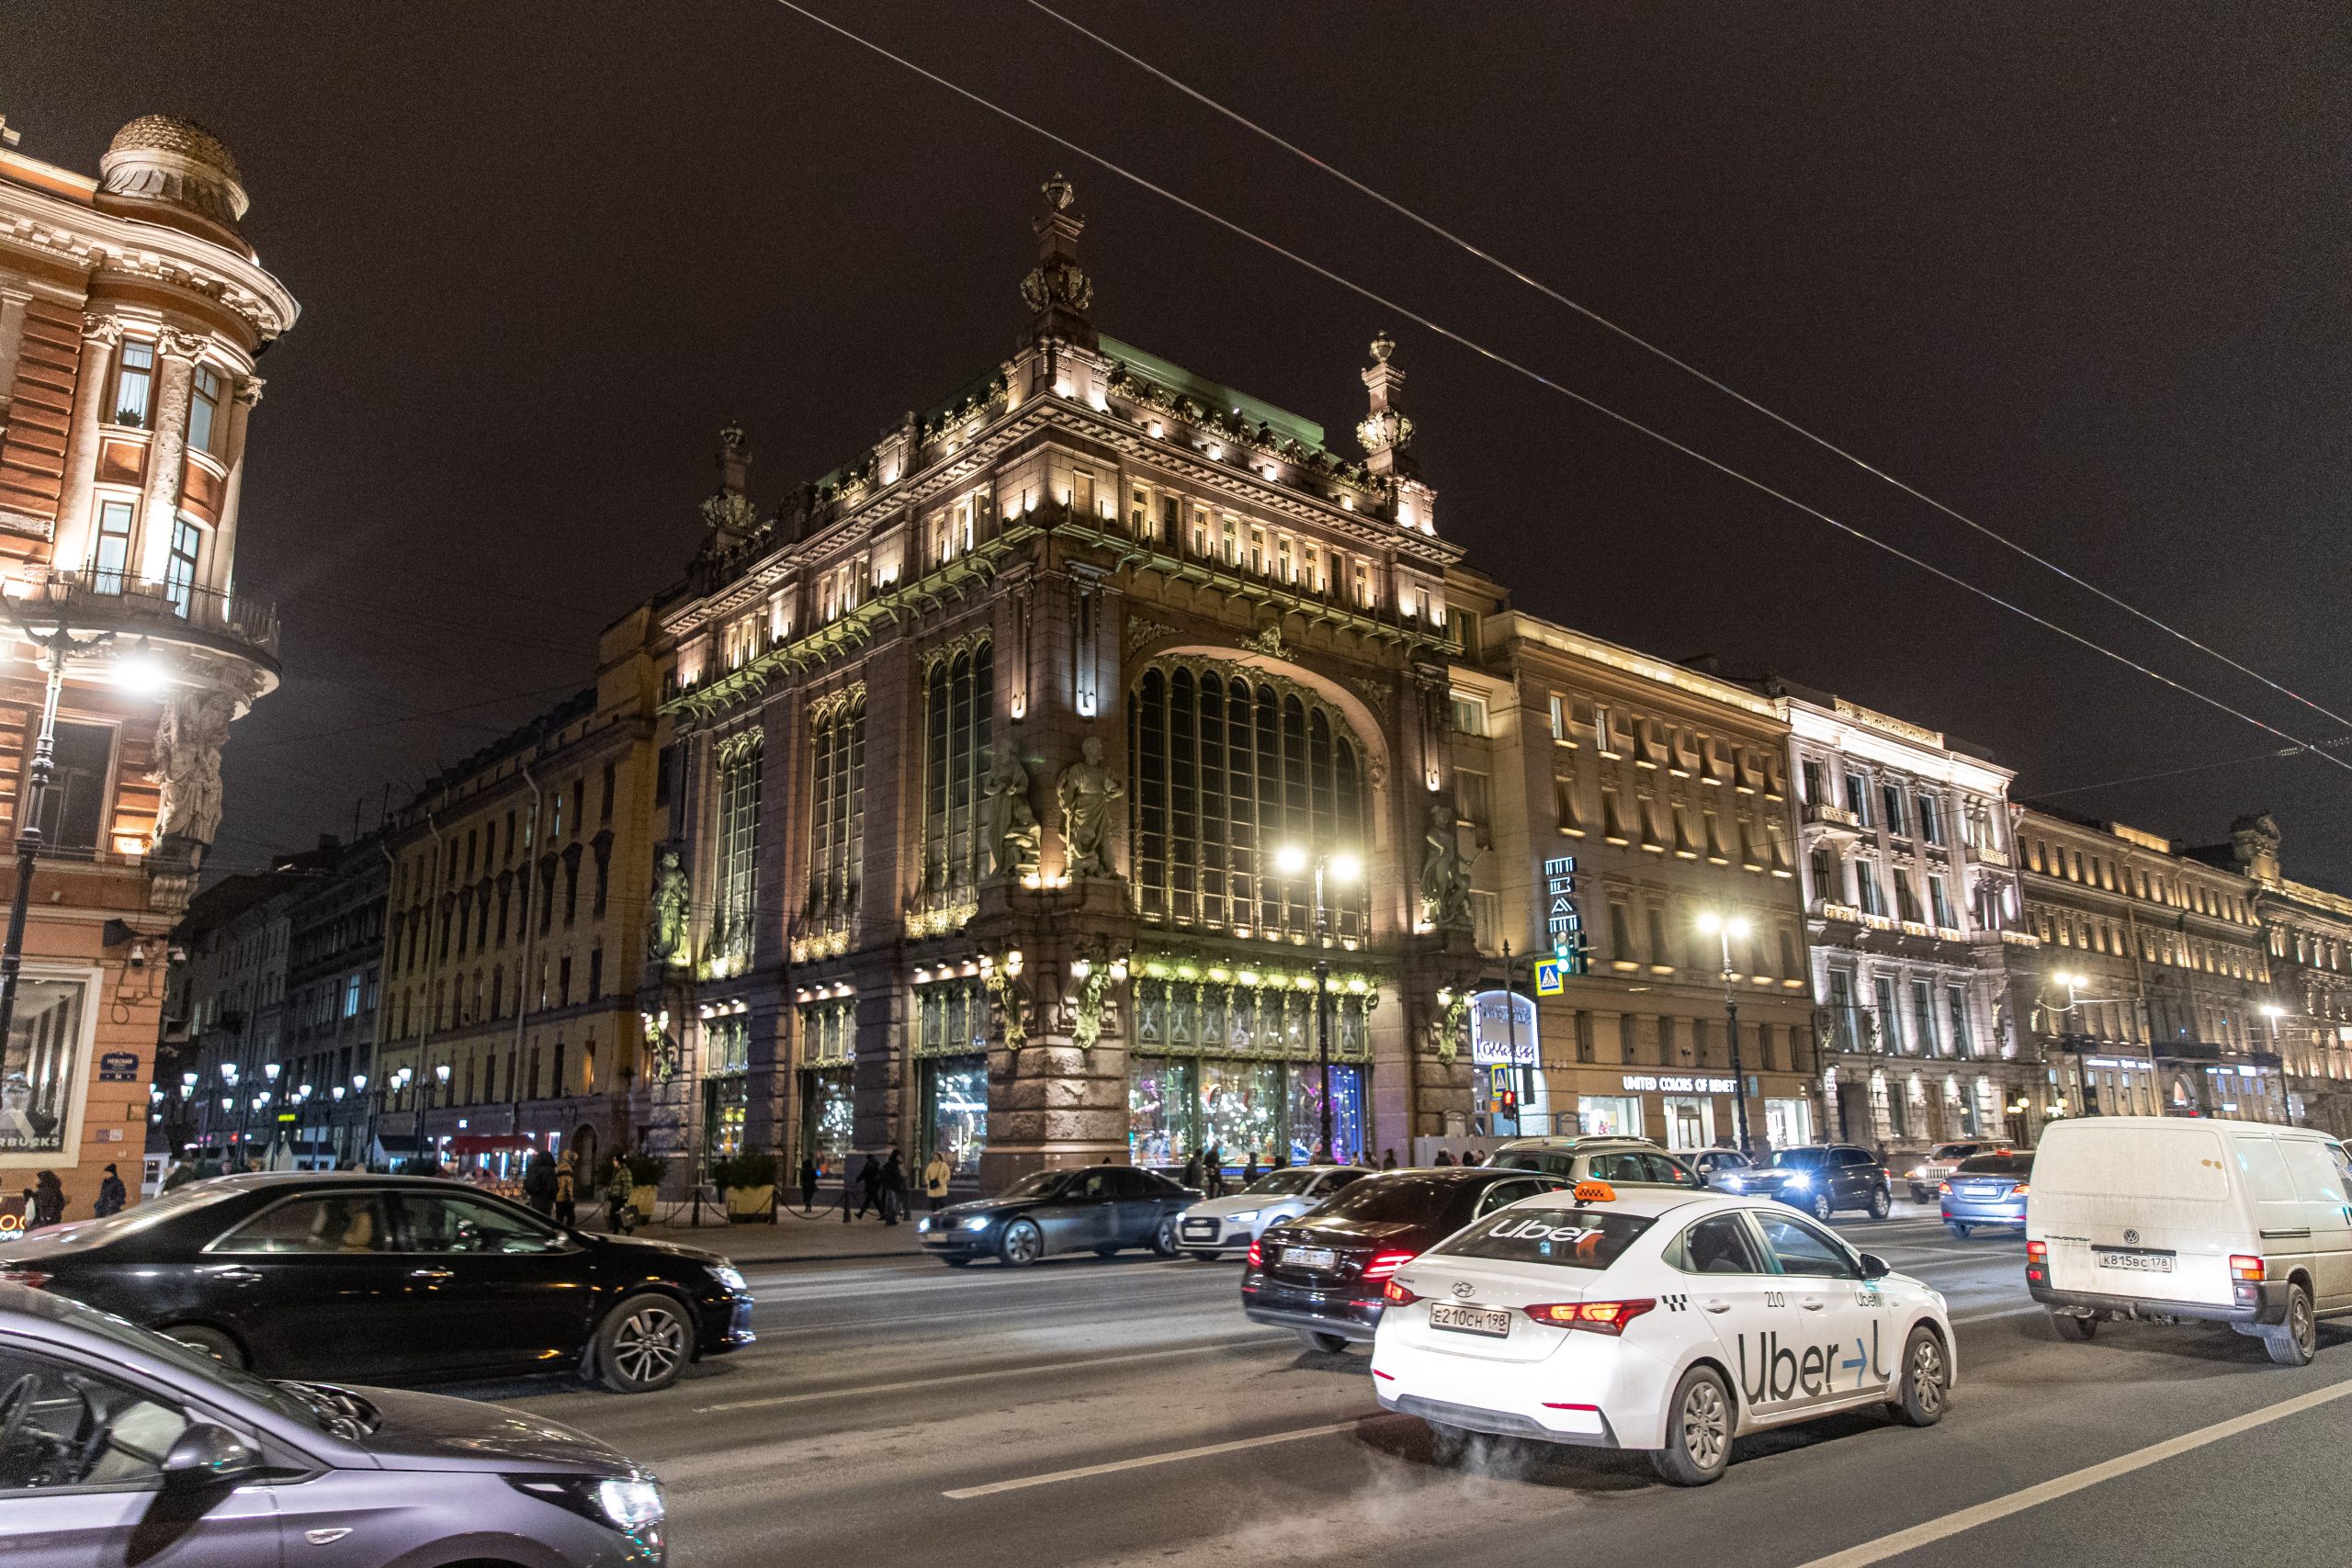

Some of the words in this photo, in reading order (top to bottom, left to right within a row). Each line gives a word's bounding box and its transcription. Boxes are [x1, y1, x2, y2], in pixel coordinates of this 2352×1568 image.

[1623, 1076, 1657, 1090] UNITED
[1659, 1077, 1693, 1091] COLORS
[1695, 1078, 1707, 1092] OF
[1488, 1219, 1605, 1244] Uber
[2150, 1257, 2168, 1267] 178
[1764, 1292, 1785, 1308] 210
[1486, 1313, 1507, 1326] 198
[1738, 1330, 1839, 1405] Uber
